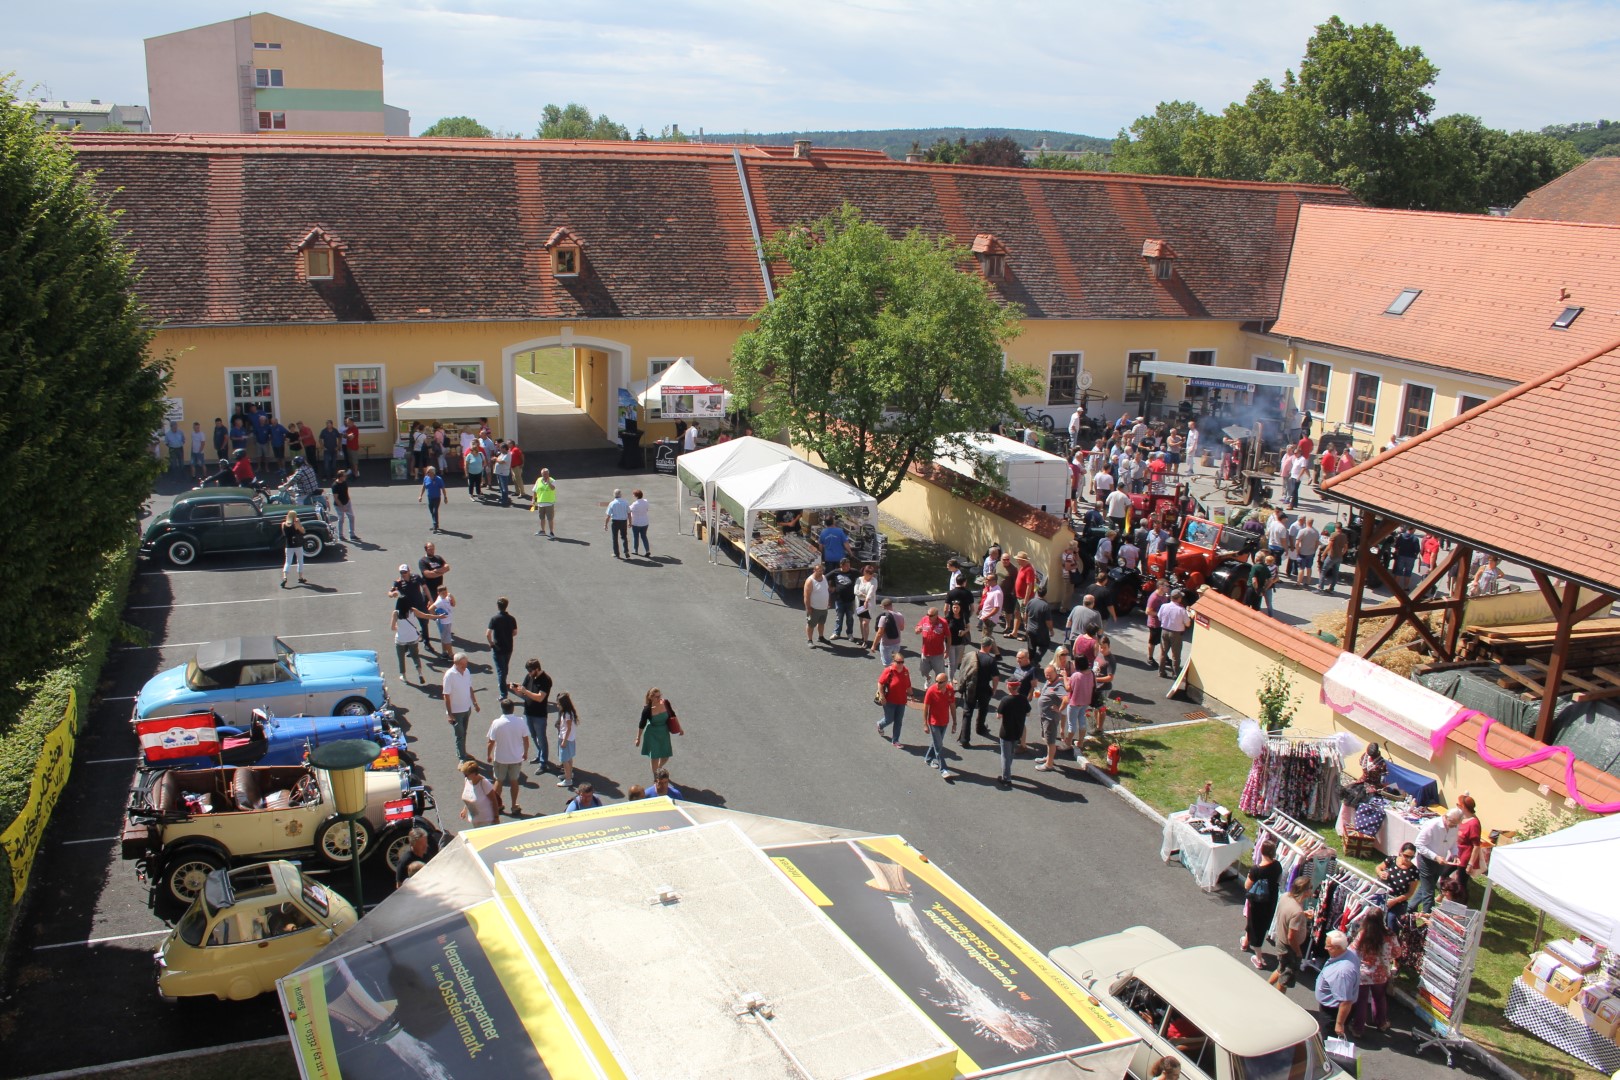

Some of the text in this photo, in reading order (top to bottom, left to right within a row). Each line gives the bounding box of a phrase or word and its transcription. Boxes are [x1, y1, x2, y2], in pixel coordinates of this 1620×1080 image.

[505, 830, 606, 853] Oststeiermark.
[922, 909, 1018, 992] Veranstaltungspartner
[998, 959, 1010, 968] der
[293, 986, 306, 1012] Hartberg
[430, 963, 485, 1059] in der Oststeiermark.
[443, 940, 499, 1041] Veranstaltungspartner
